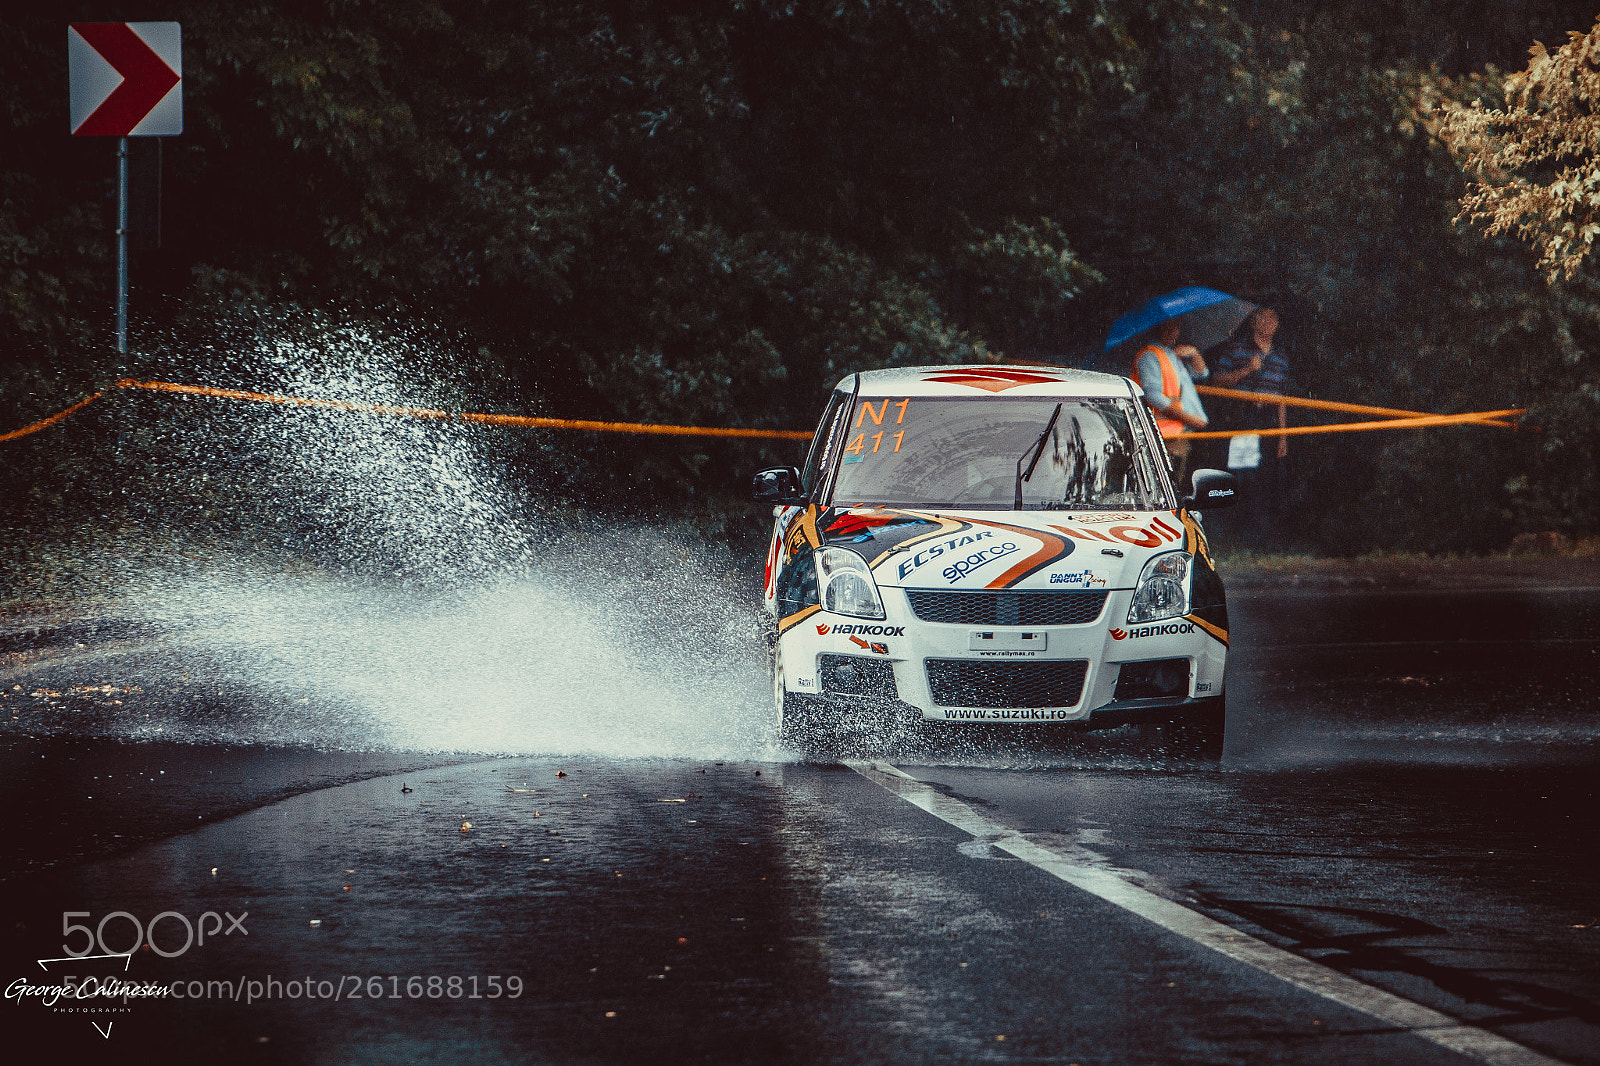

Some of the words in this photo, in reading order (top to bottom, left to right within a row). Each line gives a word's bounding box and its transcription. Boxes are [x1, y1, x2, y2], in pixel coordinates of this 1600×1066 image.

[856, 398, 910, 428] N1
[845, 430, 906, 455] 411
[897, 530, 995, 581] ECSTAR
[942, 542, 1020, 584] sparco
[1083, 573, 1107, 588] Racing
[944, 708, 1067, 720] www.suzuki.ro
